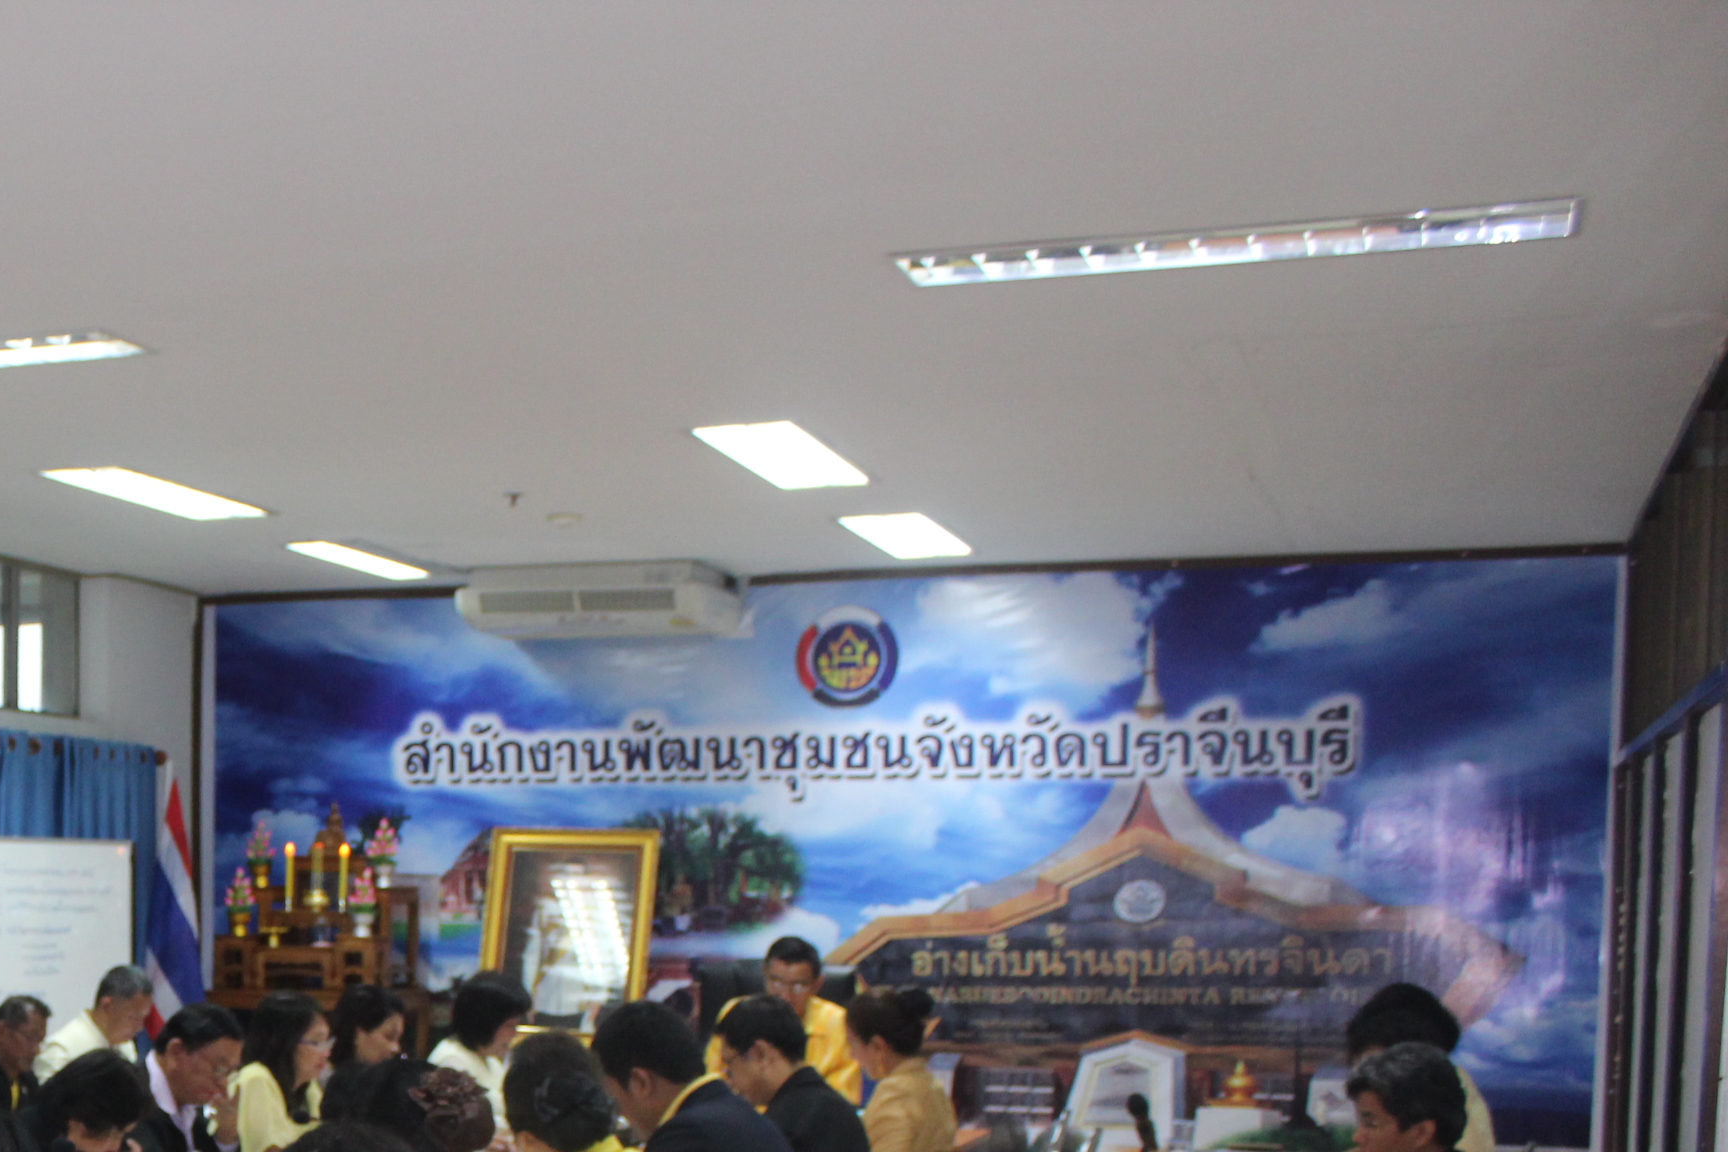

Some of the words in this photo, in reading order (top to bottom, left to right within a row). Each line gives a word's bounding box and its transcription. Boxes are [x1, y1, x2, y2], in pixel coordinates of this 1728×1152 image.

[402, 704, 1356, 801] สำนักงานพัฒนาชุมชนจังหวัดปราจีนบุรี
